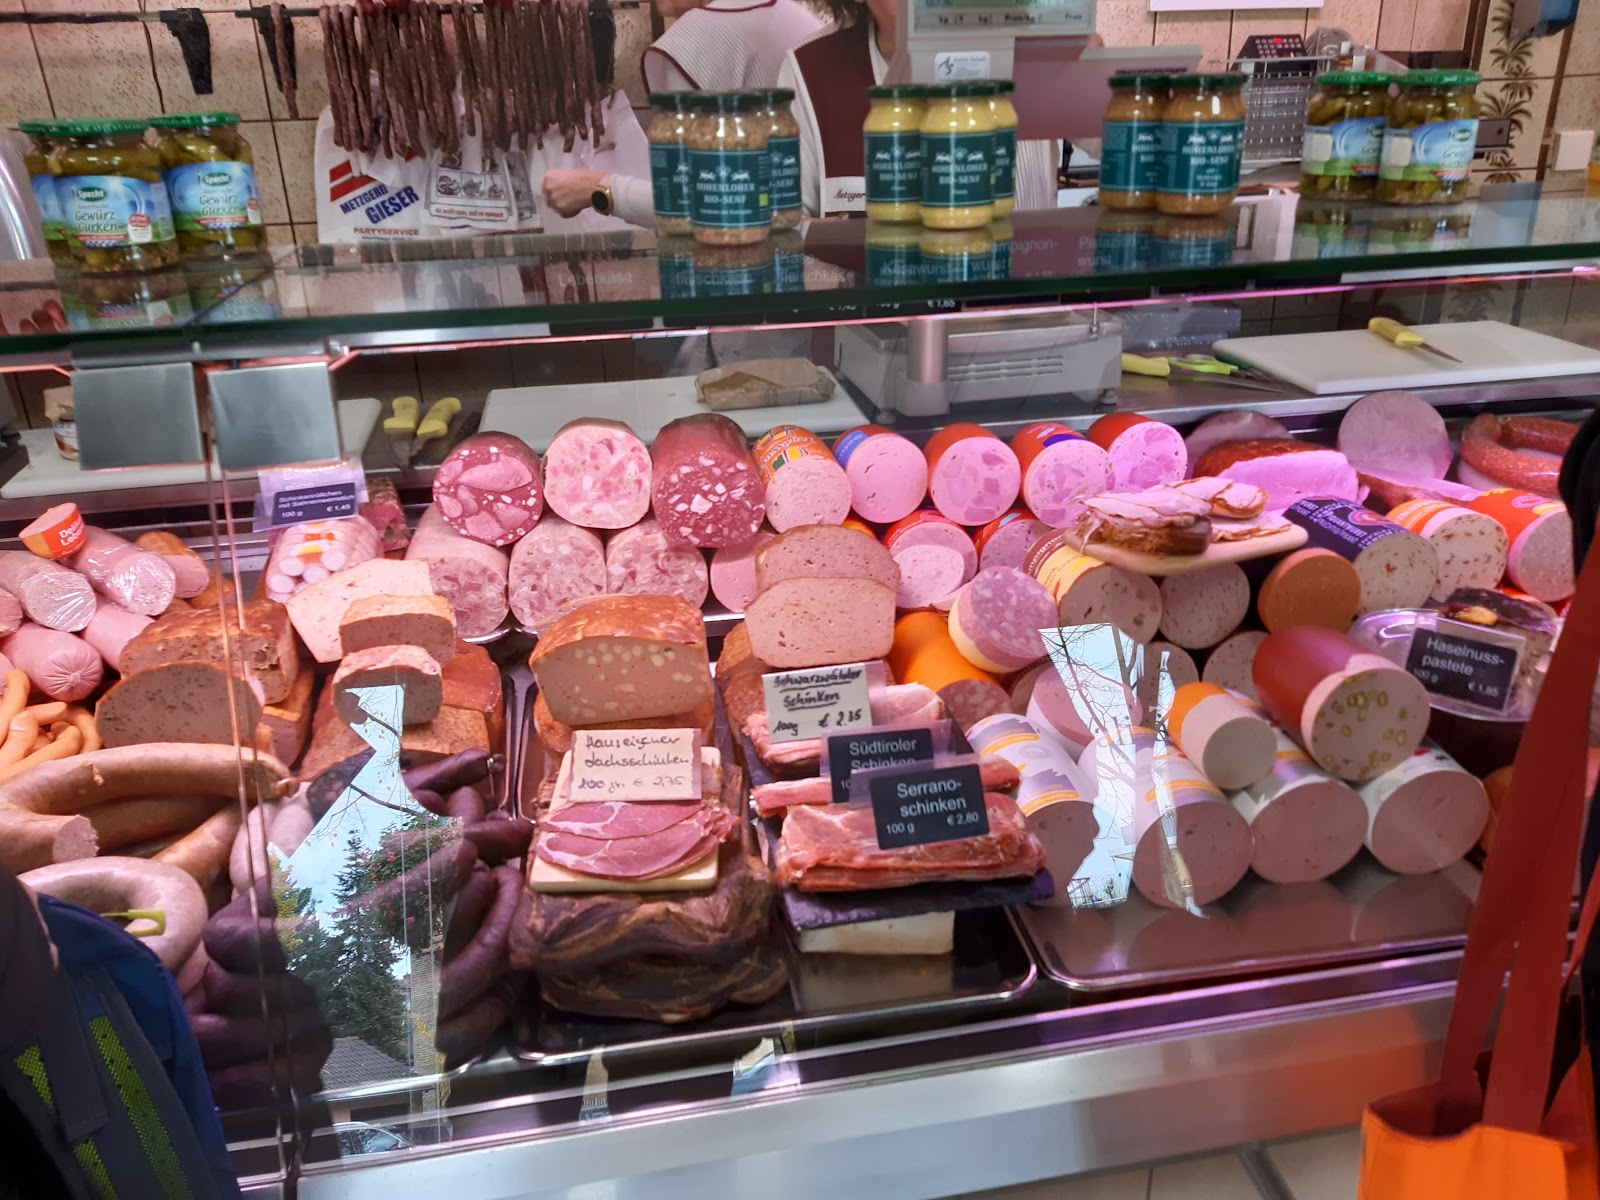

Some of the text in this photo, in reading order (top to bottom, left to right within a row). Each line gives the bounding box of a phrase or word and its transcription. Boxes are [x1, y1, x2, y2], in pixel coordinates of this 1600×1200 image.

[932, 162, 988, 173] HOHENLOHER
[204, 176, 230, 184] Specht
[939, 174, 980, 185] BIO-SENF
[77, 189, 104, 198] Specht
[697, 182, 756, 192] HOHENLOHER
[200, 195, 238, 206] Gewürz
[339, 184, 388, 214] METZGEREI
[365, 185, 420, 225] GIESER
[704, 195, 747, 204] BIO-SENF
[75, 209, 116, 222] Gewürz
[202, 206, 240, 216] Gurken
[78, 222, 118, 232] Gurken
[353, 227, 419, 236] PARTYSERVICE
[278, 490, 343, 503] Schinkenröllchen
[281, 510, 296, 518] 100
[334, 503, 351, 511] 1,45
[1426, 637, 1505, 665] Haselnuss-
[1421, 655, 1474, 676] pastete
[773, 668, 863, 689] Schwarzwälder
[1467, 681, 1477, 692] €
[783, 691, 840, 708] Schinken
[849, 738, 917, 757] Südtiroler
[897, 778, 963, 799] Serrano-
[900, 797, 967, 818] schinken
[886, 812, 980, 835] 100 g € 2,80
